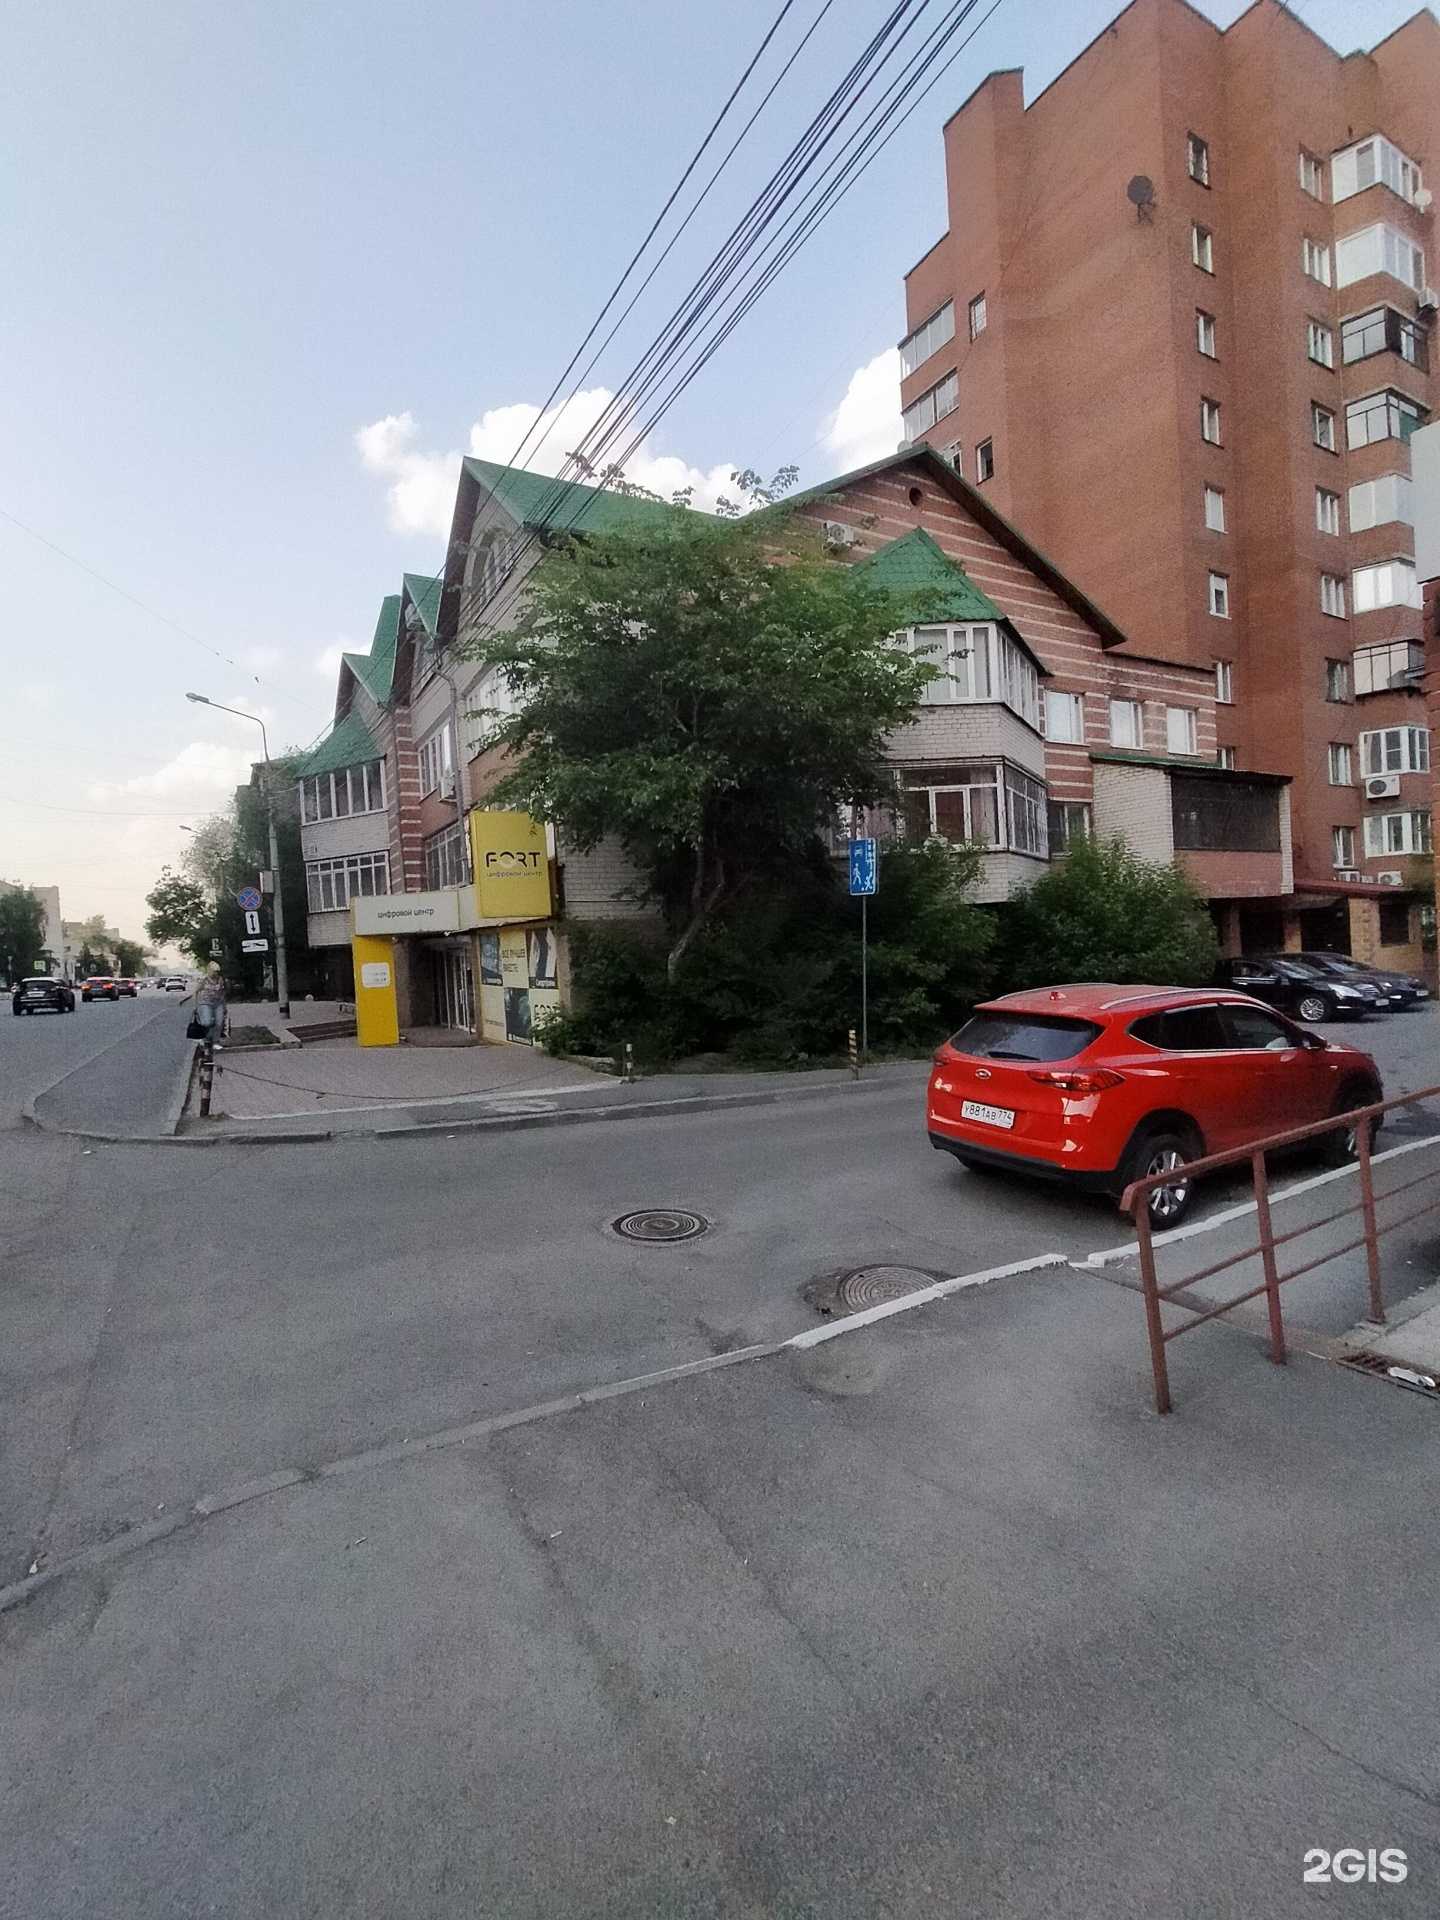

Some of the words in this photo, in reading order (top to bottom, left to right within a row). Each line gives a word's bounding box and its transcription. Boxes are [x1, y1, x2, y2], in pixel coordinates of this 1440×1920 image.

[485, 851, 541, 869] FORT
[377, 909, 412, 920] цифровой
[414, 907, 434, 918] центр
